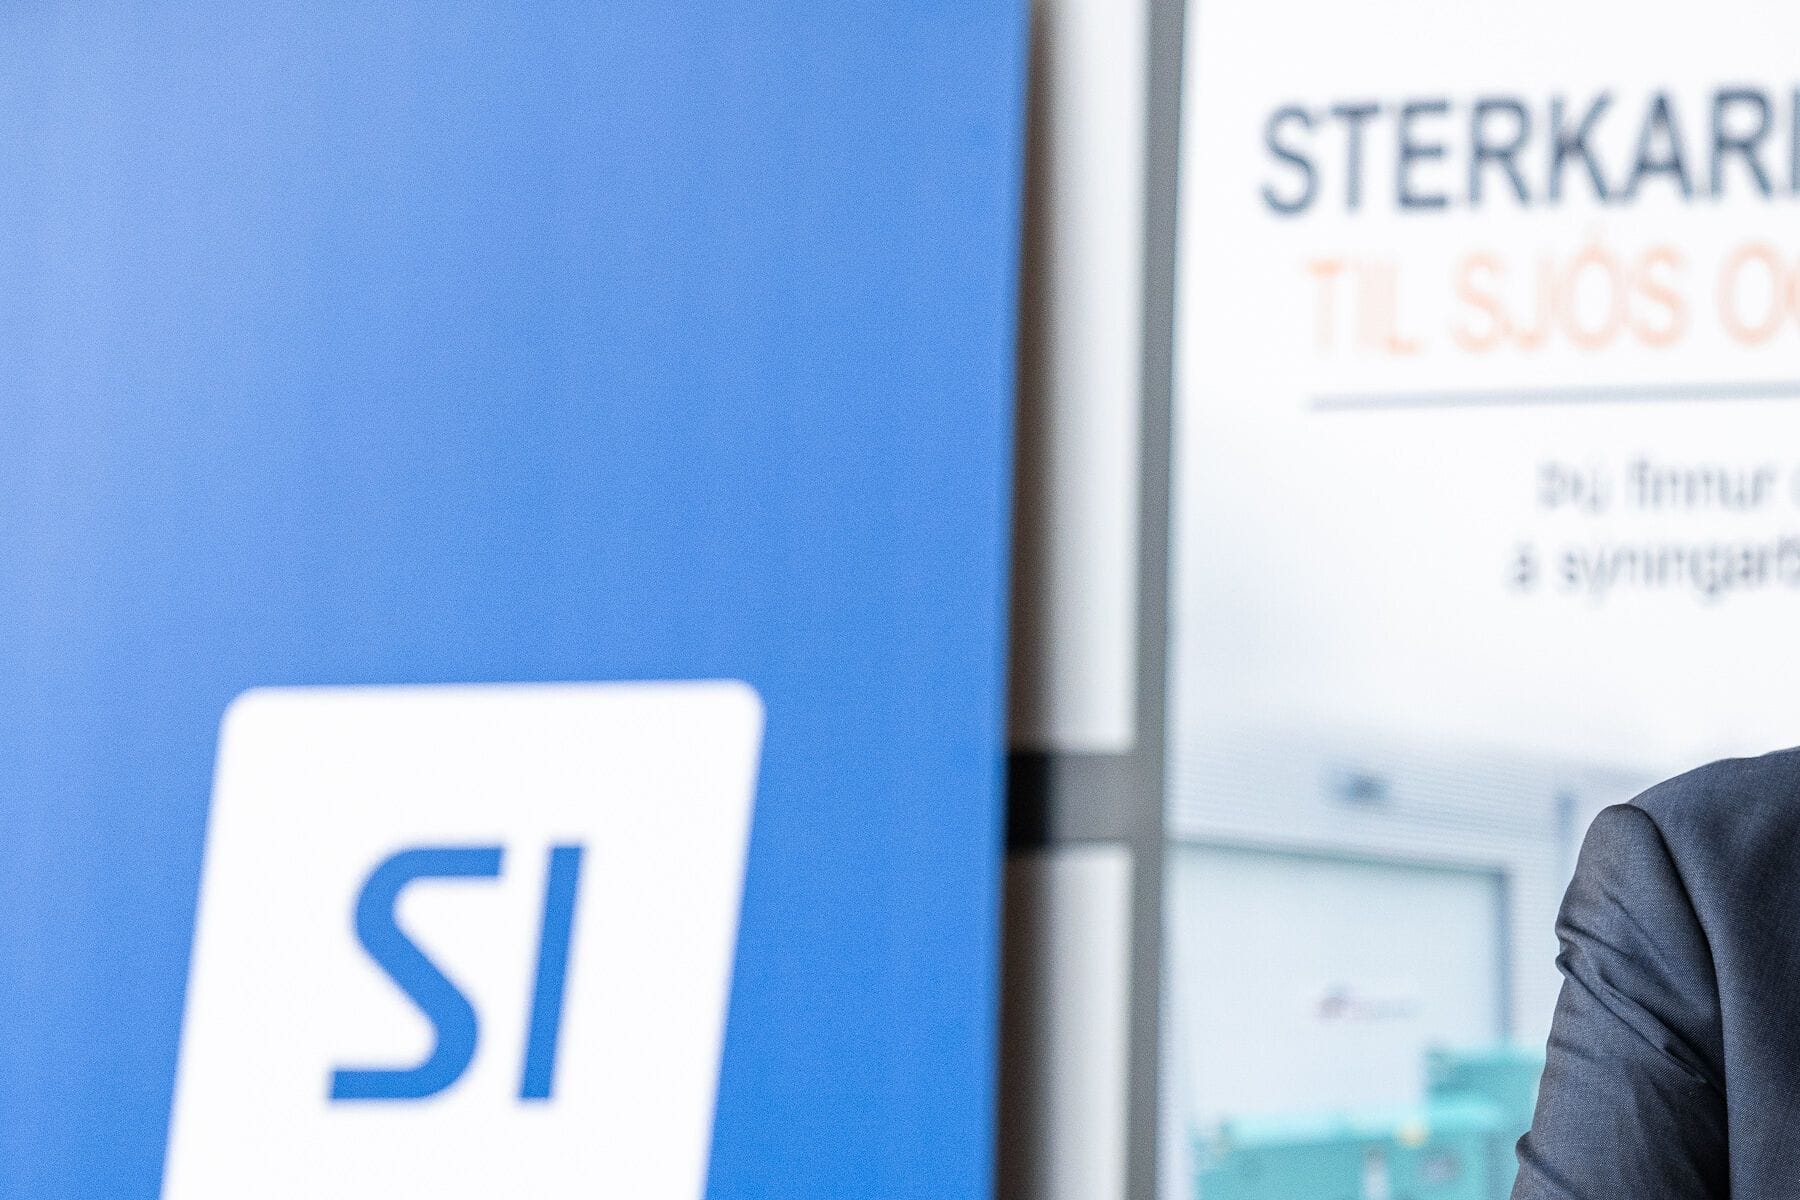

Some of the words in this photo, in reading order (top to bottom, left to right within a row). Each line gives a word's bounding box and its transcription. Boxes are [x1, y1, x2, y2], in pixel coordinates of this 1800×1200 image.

[1305, 254, 1424, 357] TIL
[1451, 222, 1694, 354] SJÓS
[327, 843, 585, 1100] SI
